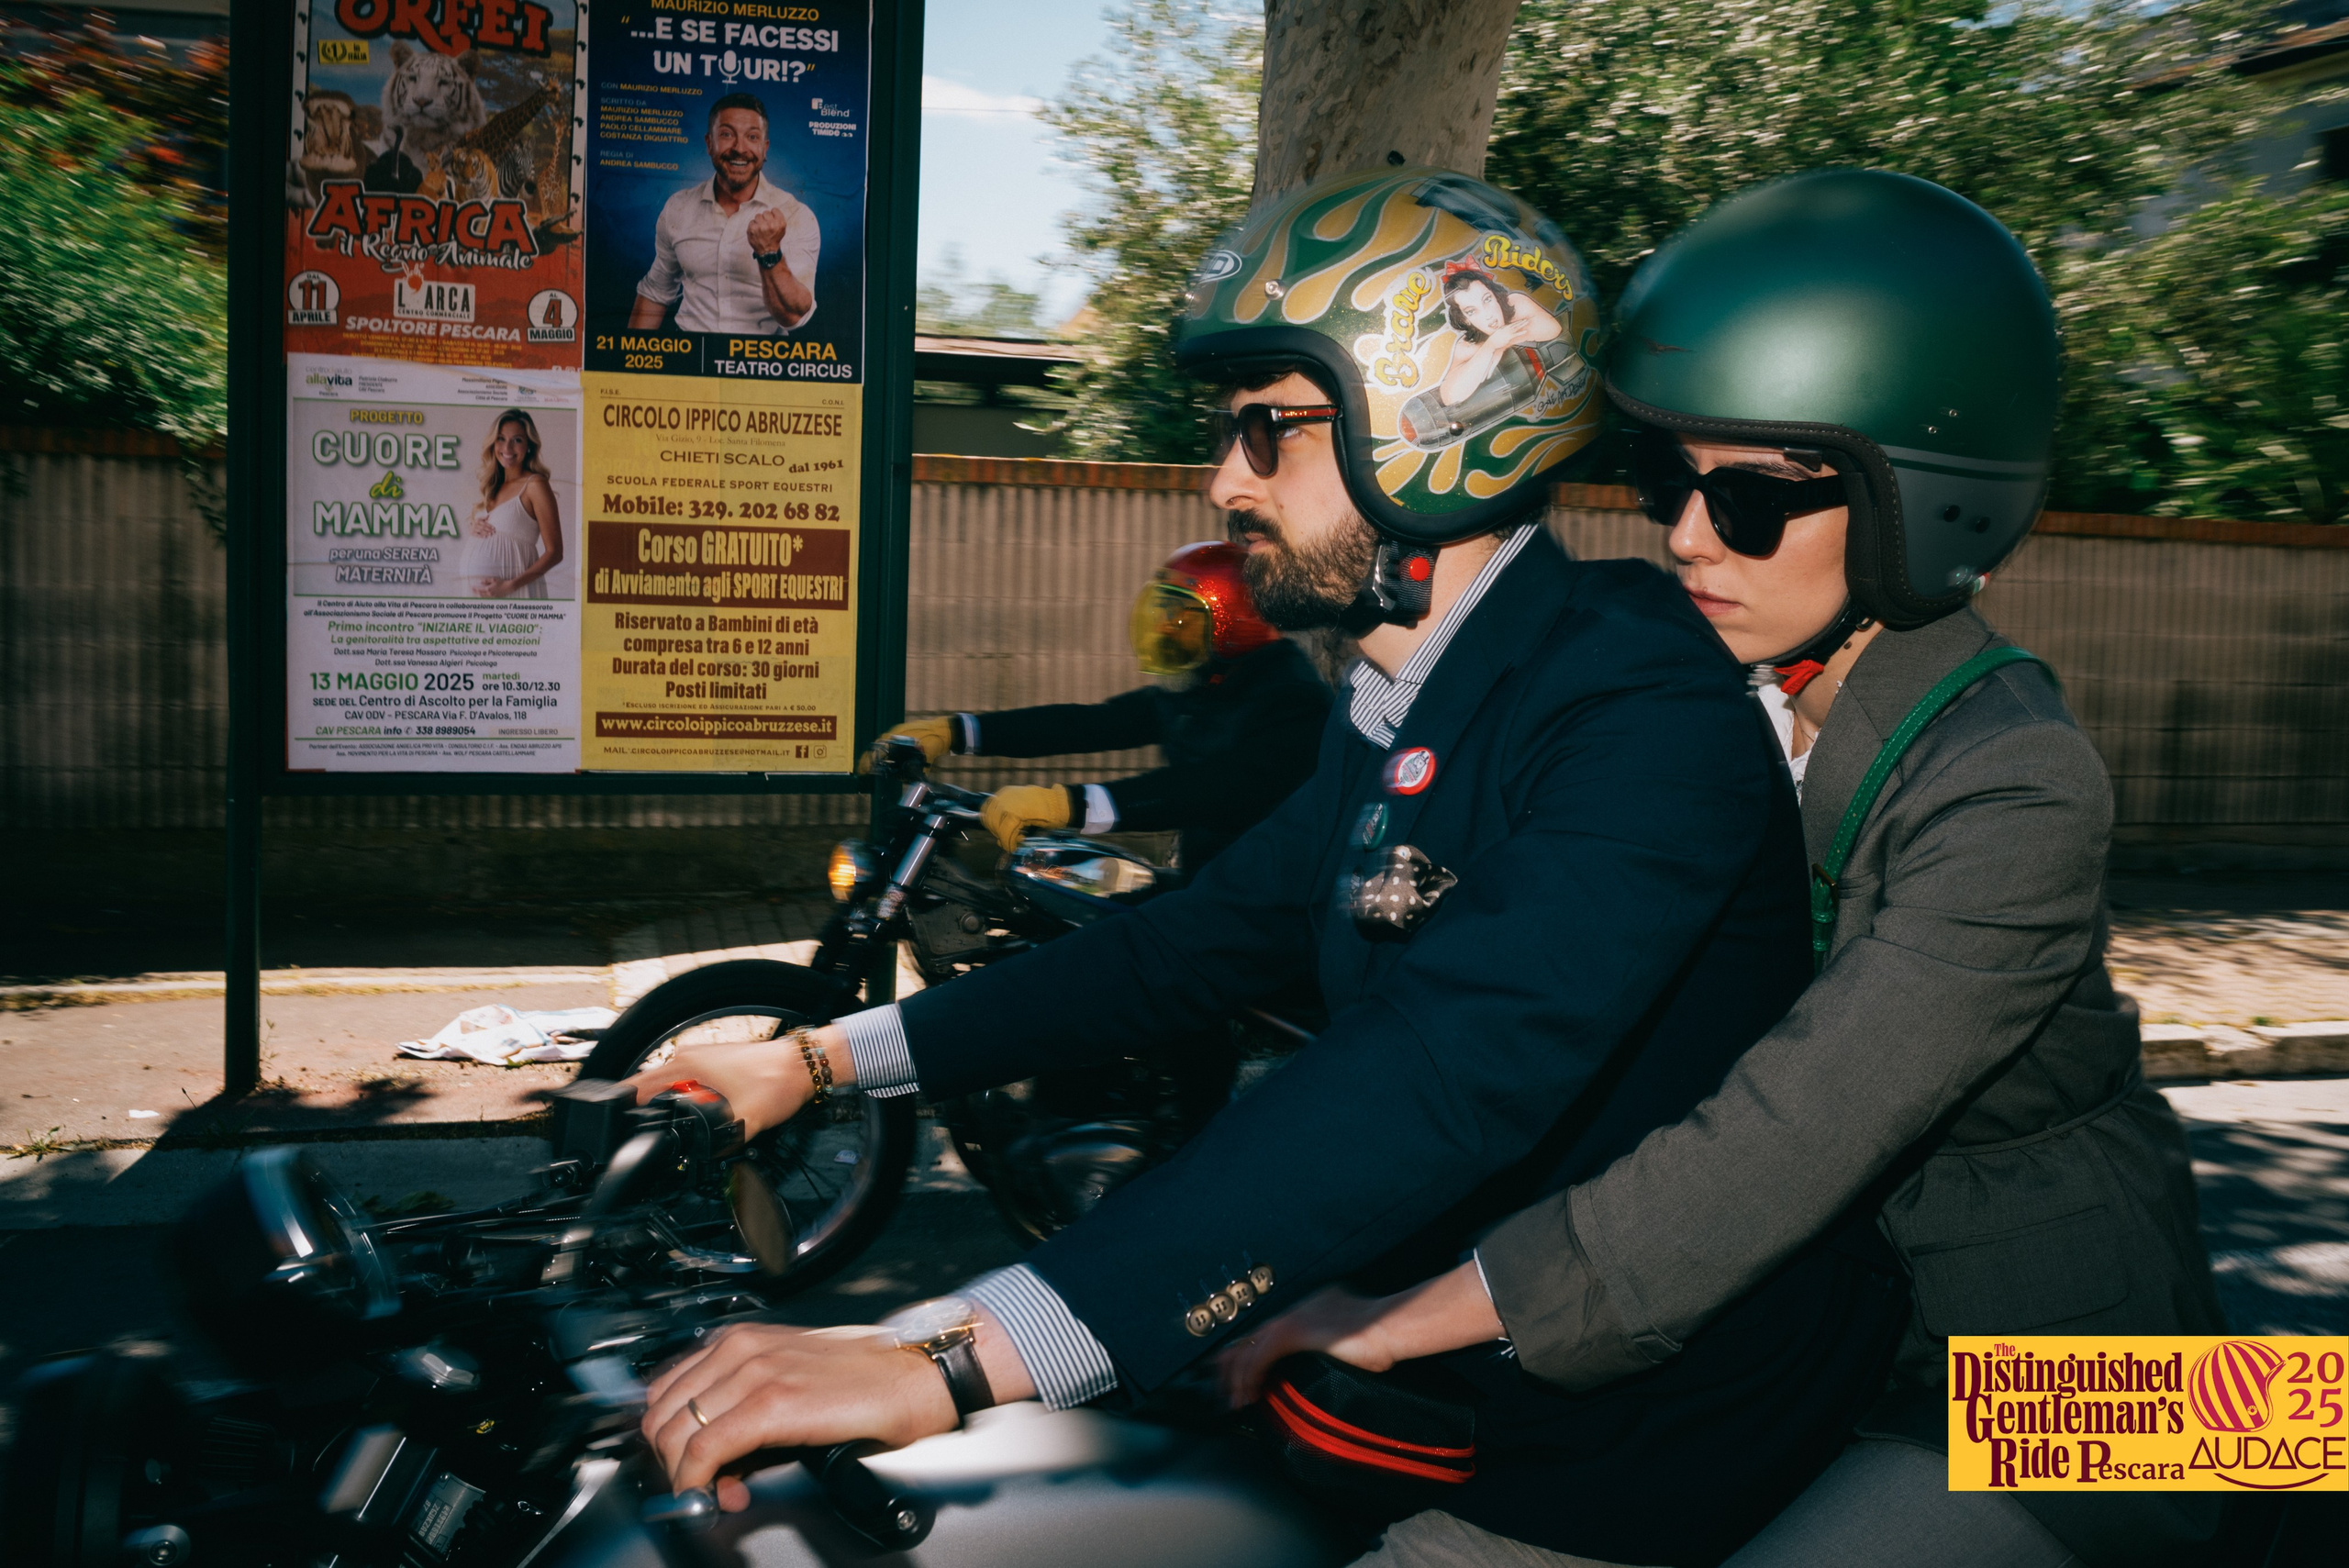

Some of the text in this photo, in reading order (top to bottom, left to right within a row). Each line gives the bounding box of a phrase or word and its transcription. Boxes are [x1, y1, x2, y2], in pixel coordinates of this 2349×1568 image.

[651, 0, 818, 21] MAURIZIO MERLUZZO
[681, 19, 716, 42] SE
[724, 23, 839, 51] FACESSI
[653, 50, 691, 74] UN
[601, 82, 702, 95] CON MAURIZIO MERLUZZO
[601, 97, 633, 106] SCRITTO
[600, 106, 683, 117] MAURIZIO MERLUZZO
[600, 115, 679, 126] ANDREA SAMBUCCO
[808, 121, 856, 130] PRODUZIONI
[600, 132, 688, 144] COSTANZA DIQUATTRO
[629, 125, 682, 134] CELLAMMARE
[600, 159, 678, 171] ANDREA SAMBUCCO
[309, 183, 537, 255] AFRICA
[436, 240, 532, 270] Animale
[1483, 235, 1574, 303] Riders
[298, 280, 327, 310] 11
[293, 312, 330, 322] APRILE
[426, 311, 470, 319] COMMERCIALE
[542, 299, 562, 327] 4
[346, 317, 436, 335] SPOLTORE
[440, 324, 520, 341] PESCARA
[529, 328, 573, 339] MAGGIO
[1370, 270, 1432, 387] Brave
[597, 337, 692, 352] 21 MAGGIO
[729, 339, 837, 360] PESCARA
[625, 355, 662, 368] 2025
[714, 360, 852, 378] TEATRO CIRCUS
[351, 410, 423, 424] PROGETTO
[604, 405, 841, 436] CIRCOLO IPPICO ABRUZZESE
[313, 430, 458, 467] CUORE
[660, 450, 785, 466] CHIETI SCALO
[788, 460, 843, 473] dal 1961
[370, 472, 403, 498] di
[607, 475, 832, 494] SCUOLA FEDERALE SPORT EQUESTRI
[603, 495, 840, 522] Mobile: 329. 202 68 82
[314, 502, 458, 536] MAMMA
[639, 528, 696, 564] Corso
[329, 548, 438, 562] per una SERENA
[336, 565, 431, 583] MATERNITÀ
[596, 568, 843, 603] di Avviamento agli SPORT EQUESTRI
[328, 621, 362, 633] Primo
[365, 623, 414, 633] incontro
[417, 623, 472, 633] "INIZIARE
[475, 623, 484, 633] IL
[615, 612, 818, 633] Riservato a Bambini di età
[331, 635, 342, 644] La
[406, 636, 421, 644] tra
[423, 636, 480, 646] aspettative
[482, 637, 494, 645] ed
[496, 637, 540, 646] emozioni
[623, 637, 808, 655] compresa tra 6 e 12 anni
[613, 658, 818, 681] Durata del corso: 30 giorni
[311, 673, 330, 690] 13
[337, 673, 418, 691] MAGGIO
[424, 673, 473, 691] 2025
[502, 682, 560, 692] 10.30/12.30
[666, 682, 766, 699] Posti limitati
[313, 695, 557, 708] SEDE DEL Centro di Ascolto per la Famiglia
[345, 711, 363, 719] CAV
[366, 711, 385, 719] ODV
[395, 711, 439, 719] PESCARA
[442, 711, 457, 719] Via
[460, 711, 466, 719] F.
[469, 711, 511, 720] D'Avalos,
[514, 711, 527, 719] 118
[316, 726, 475, 735] CAV PESCARA info 338 8989054
[601, 717, 831, 734] www.circoloippicoabruzzese.it
